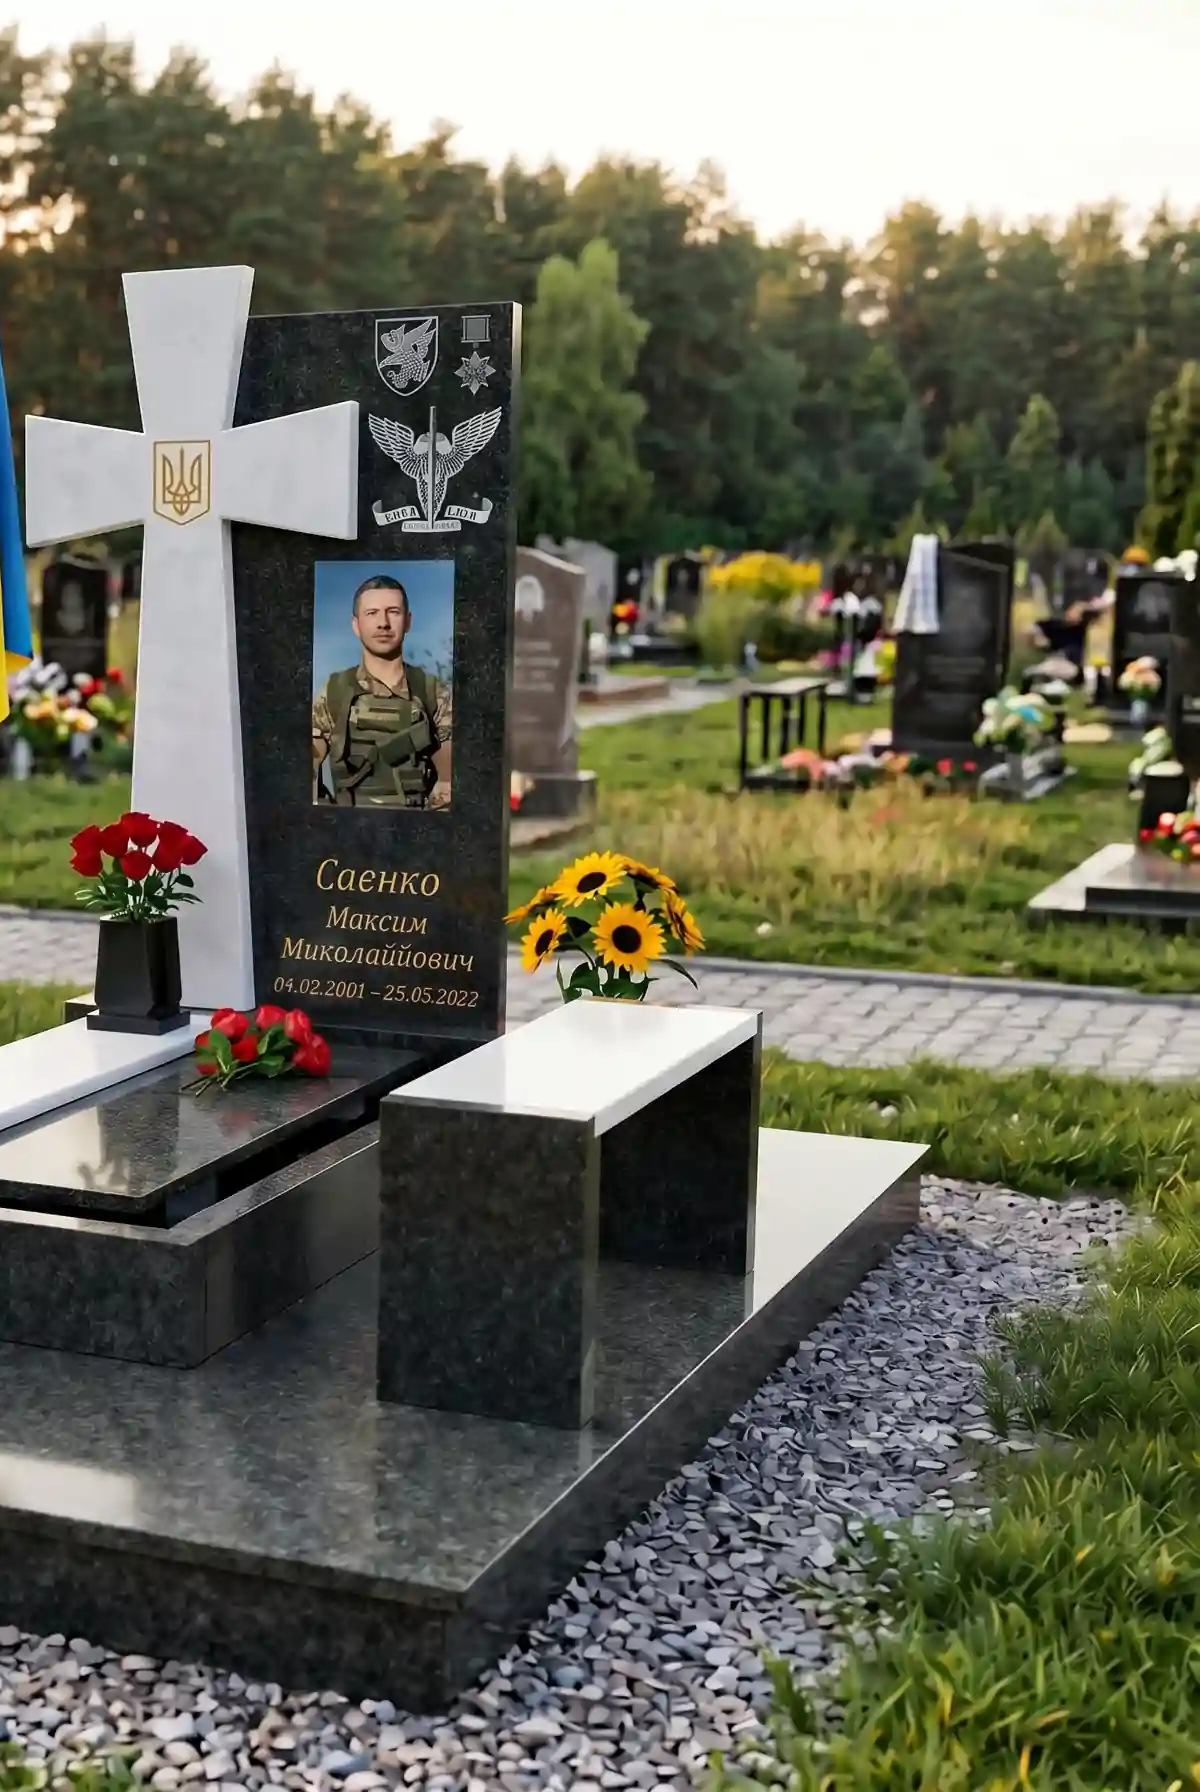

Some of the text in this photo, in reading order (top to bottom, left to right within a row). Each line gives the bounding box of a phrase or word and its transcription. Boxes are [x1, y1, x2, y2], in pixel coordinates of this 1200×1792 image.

[316, 858, 440, 896] Саєнко
[325, 905, 429, 935] Максим
[280, 936, 474, 972] Миколаййович
[273, 976, 365, 1000] 04.02.2001
[382, 983, 479, 1008] 25.05.2022
